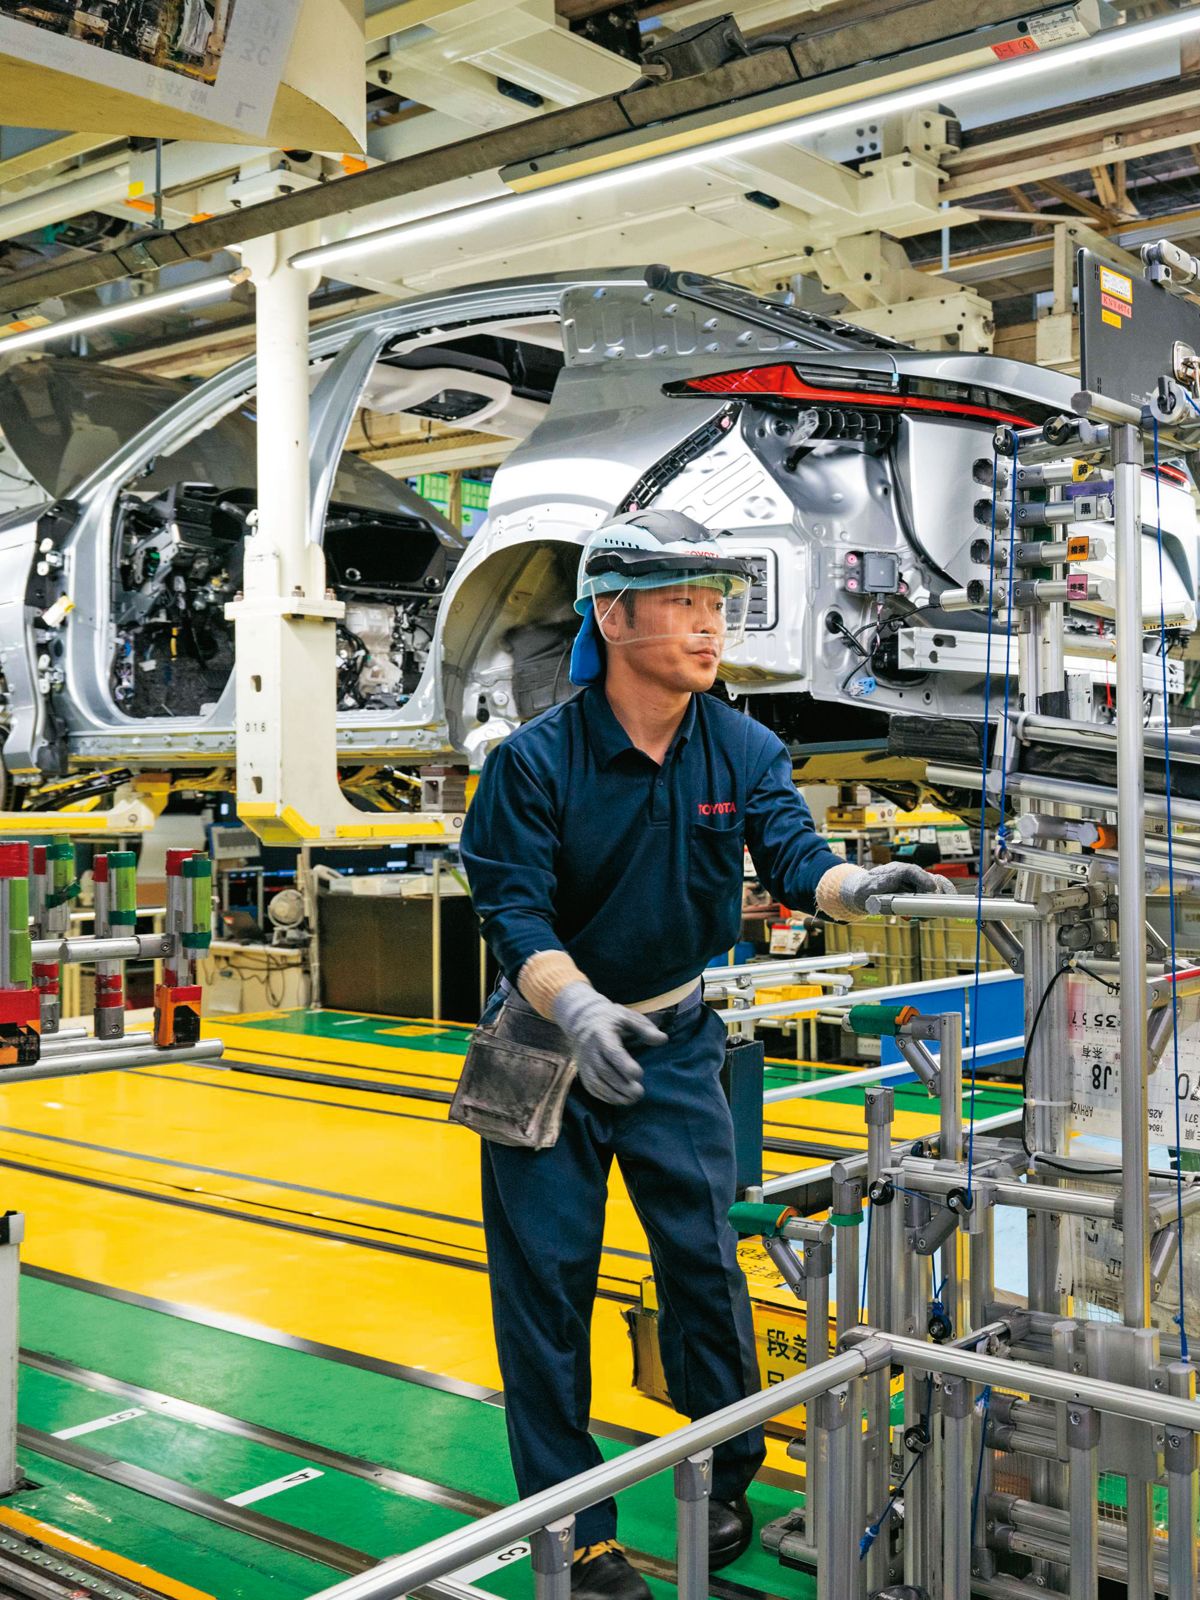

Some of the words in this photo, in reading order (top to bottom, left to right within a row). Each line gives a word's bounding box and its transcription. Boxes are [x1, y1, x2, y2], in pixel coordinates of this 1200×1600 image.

[697, 801, 737, 816] TOYOTA
[1094, 1013, 1118, 1028] 35
[497, 1546, 528, 1561] 3
